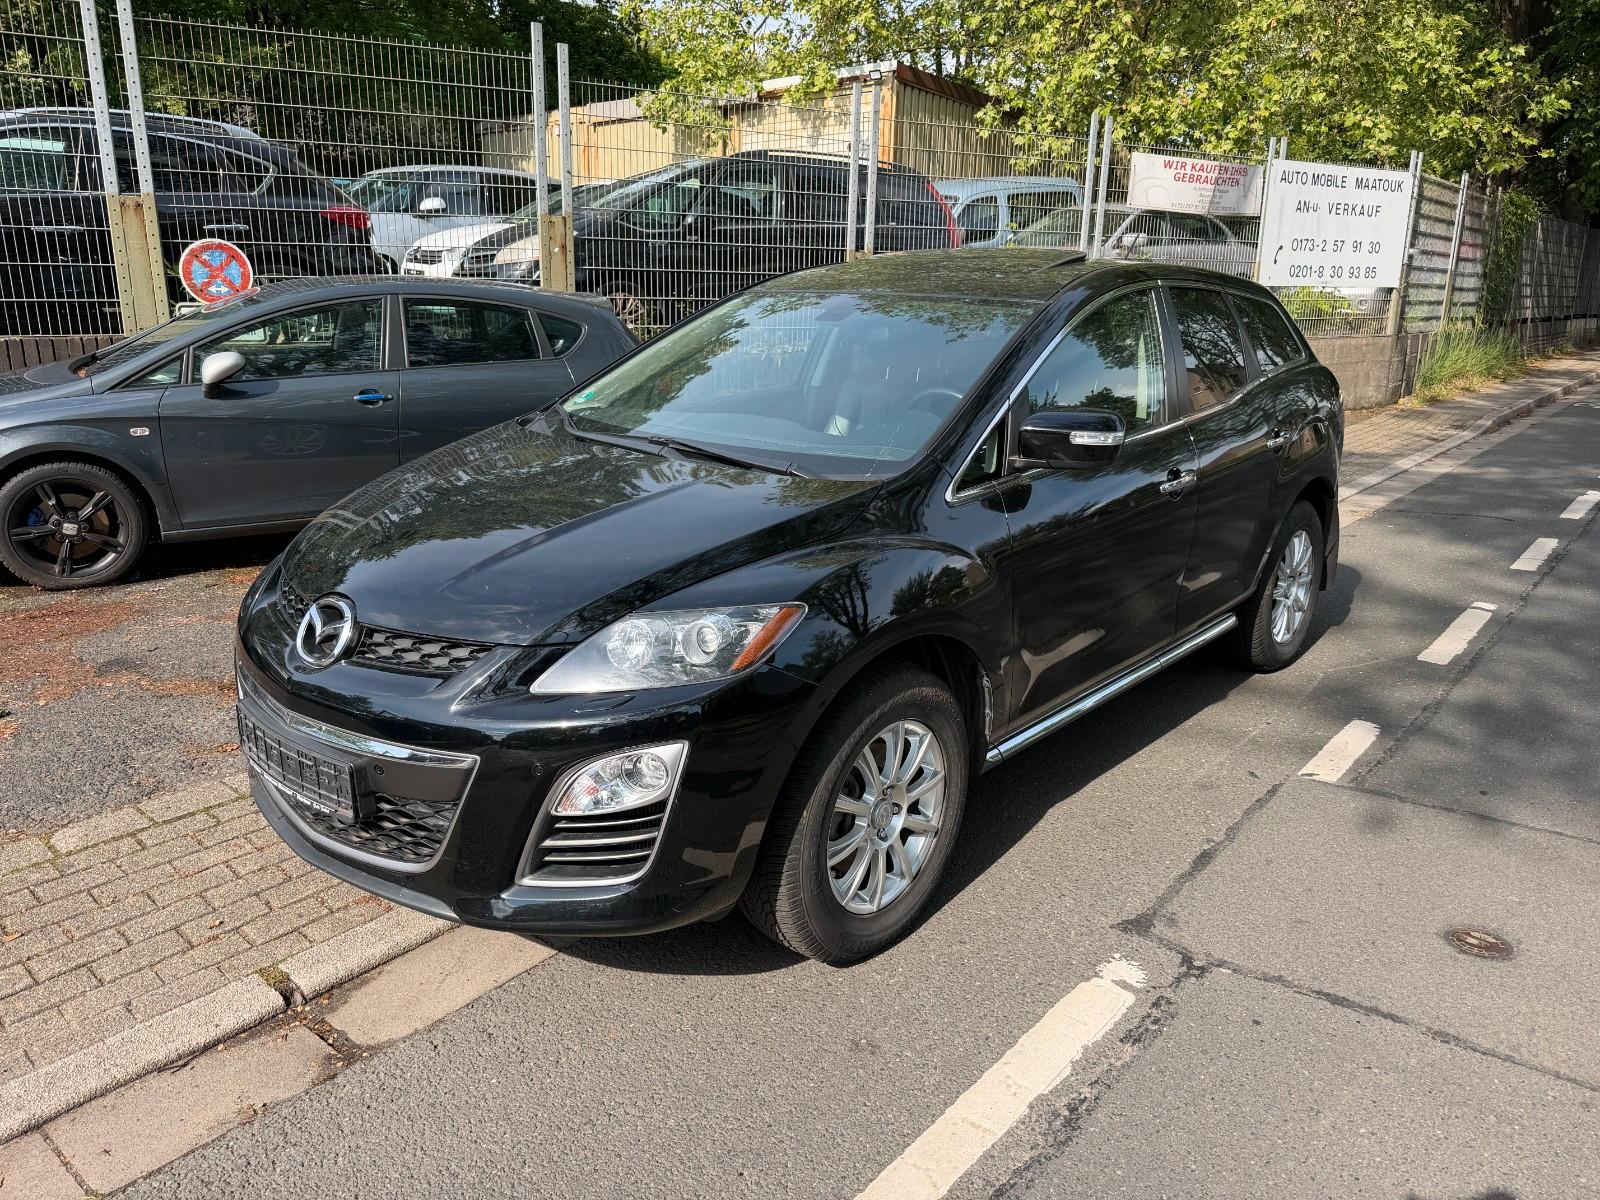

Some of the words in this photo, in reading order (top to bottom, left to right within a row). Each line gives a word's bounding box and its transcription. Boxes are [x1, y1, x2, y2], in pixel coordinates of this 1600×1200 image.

[1163, 160, 1187, 171] WIR
[1191, 163, 1229, 175] KAUFEN
[1173, 172, 1240, 187] GEBRAUCHTEN
[1280, 170, 1308, 185] AUTO
[1312, 173, 1347, 188] MOBILE
[1355, 177, 1404, 192] MAATOUK
[1328, 202, 1381, 218] VERKAUF
[1291, 237, 1327, 253] 0173-2
[1332, 239, 1345, 253] 57
[1352, 240, 1363, 253] 91
[1367, 241, 1381, 254] 30
[1289, 264, 1325, 279] 0201-8
[1329, 265, 1343, 279] 30
[1348, 266, 1361, 279] 93
[1364, 266, 1377, 279] 85
